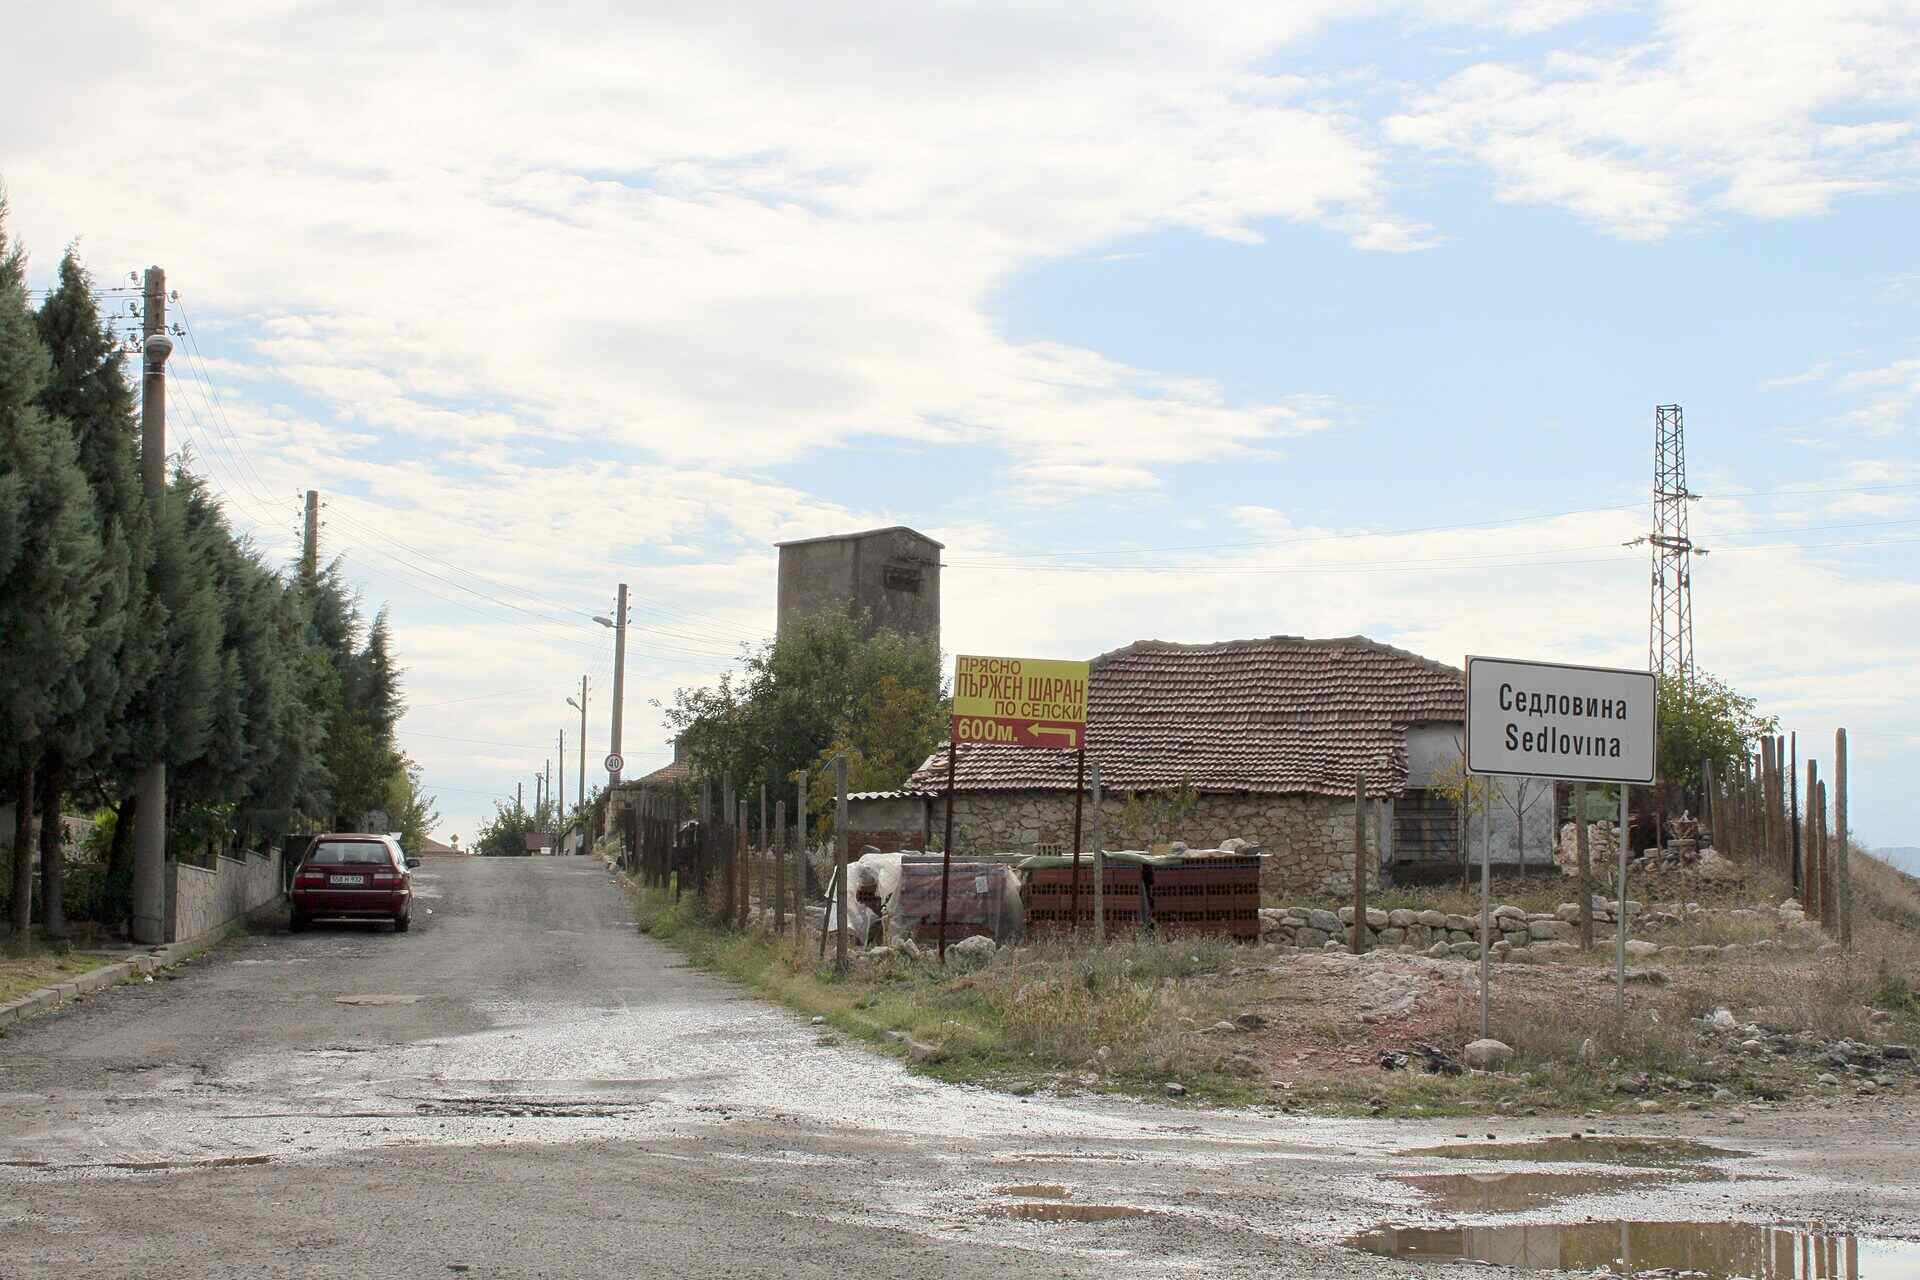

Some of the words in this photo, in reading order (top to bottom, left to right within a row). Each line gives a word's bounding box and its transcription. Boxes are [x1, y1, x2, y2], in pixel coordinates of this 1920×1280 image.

[959, 657, 1021, 674] ПРЯСНО
[957, 673, 1022, 700] ПЪРЖЕН
[1029, 677, 1083, 704] ШАРАН
[995, 701, 1016, 716] ПО
[1021, 702, 1083, 720] СЕЛСКИ
[1499, 683, 1627, 720] Седловина
[1505, 723, 1621, 758] Sedlovina
[609, 758, 619, 769] 40
